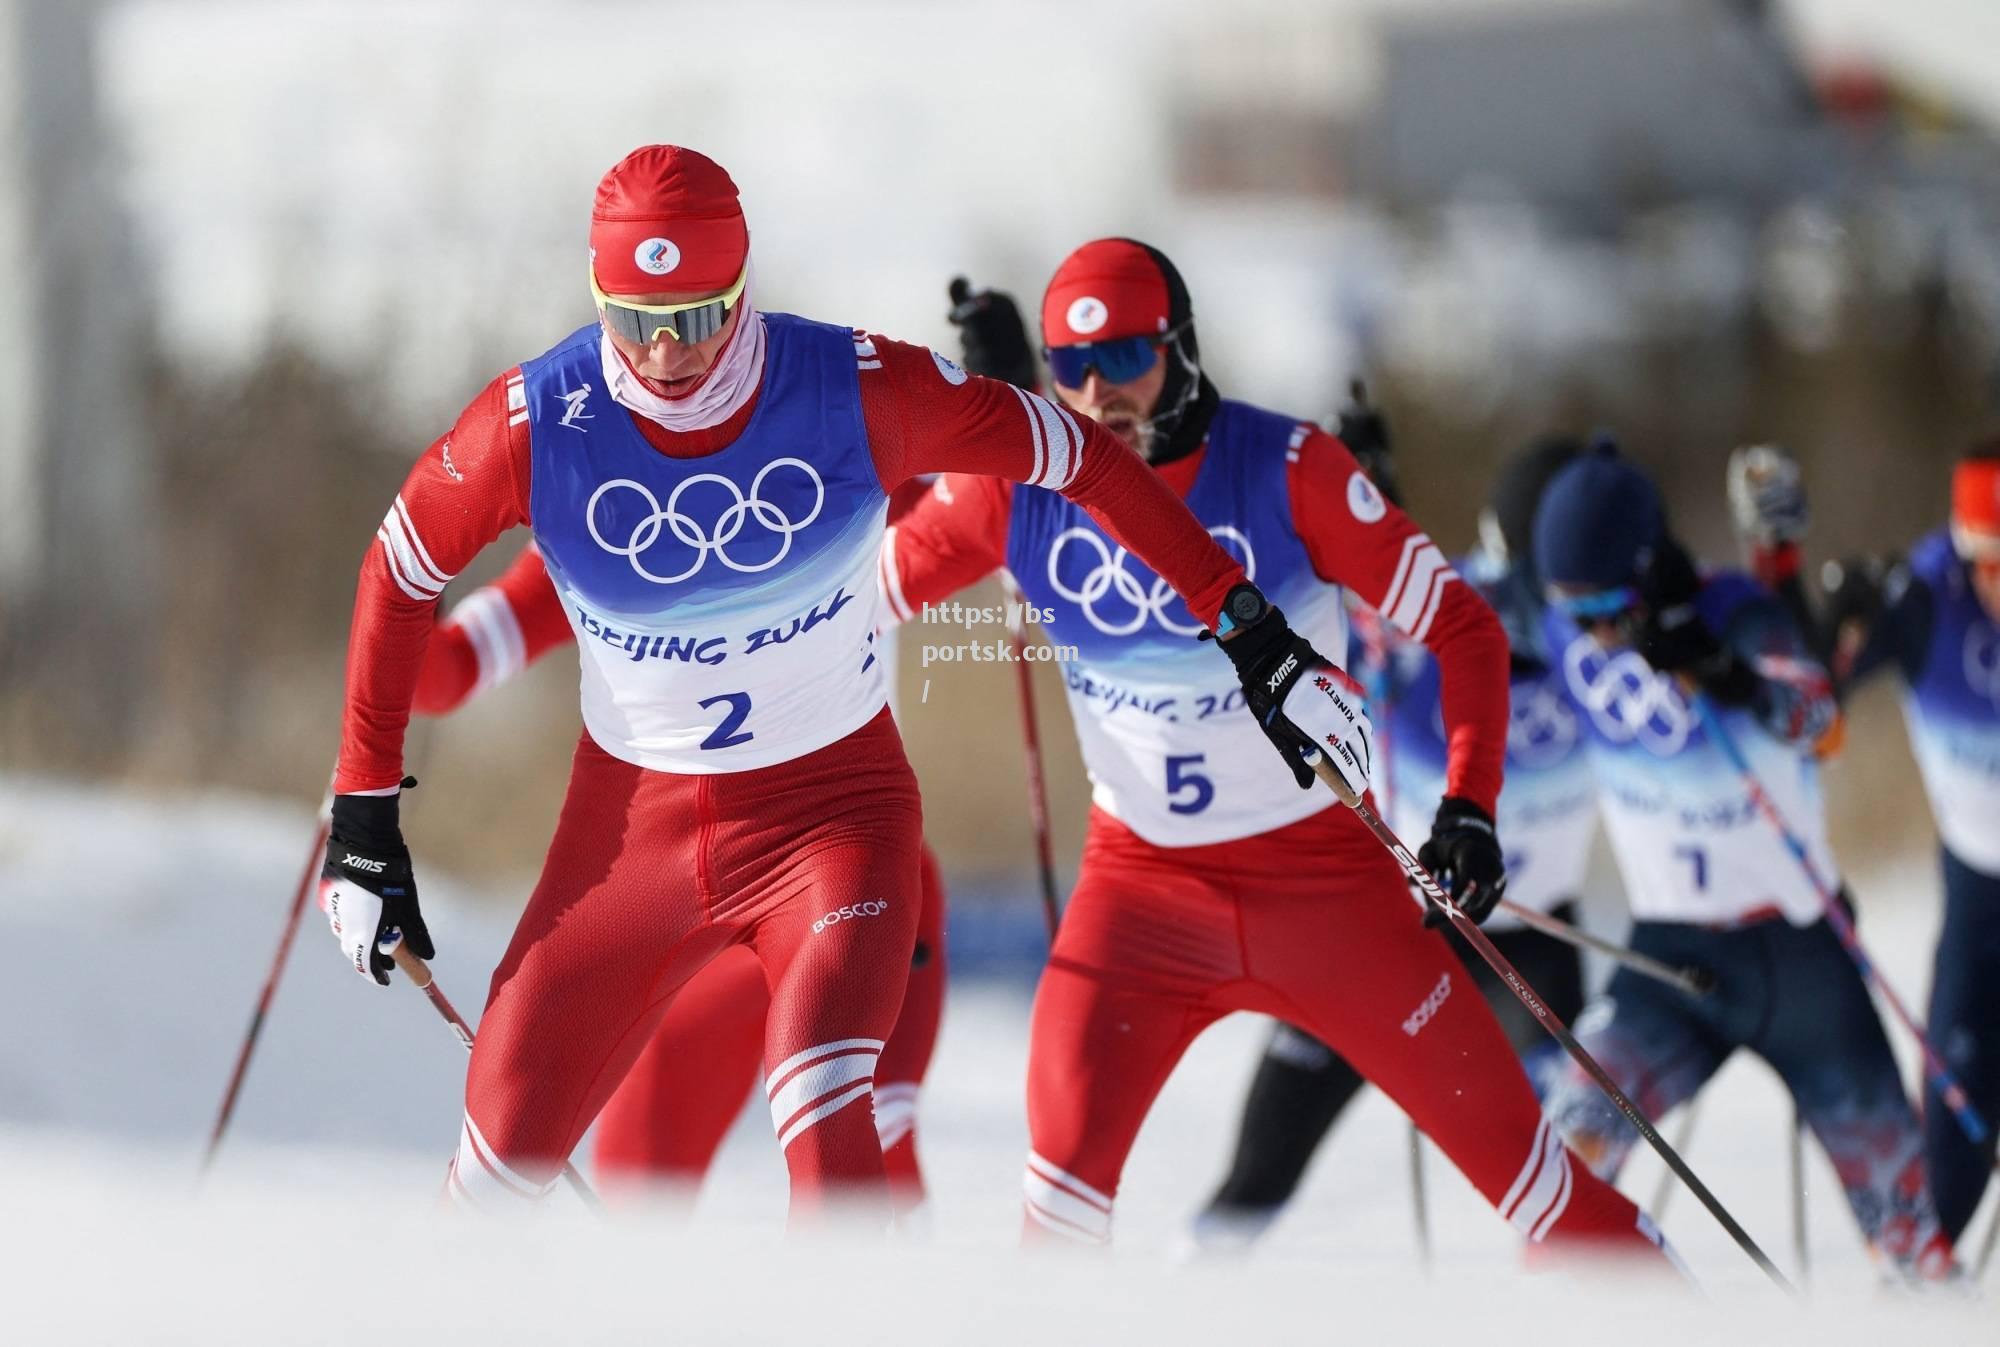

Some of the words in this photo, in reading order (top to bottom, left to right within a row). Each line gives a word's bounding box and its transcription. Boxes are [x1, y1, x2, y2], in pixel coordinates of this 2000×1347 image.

[576, 605, 728, 666] BEIJING
[1266, 652, 1299, 694] SWIX
[697, 691, 754, 751] 2
[1165, 753, 1216, 816] 5
[342, 853, 387, 873] SWIX
[1388, 844, 1466, 919] SWIX
